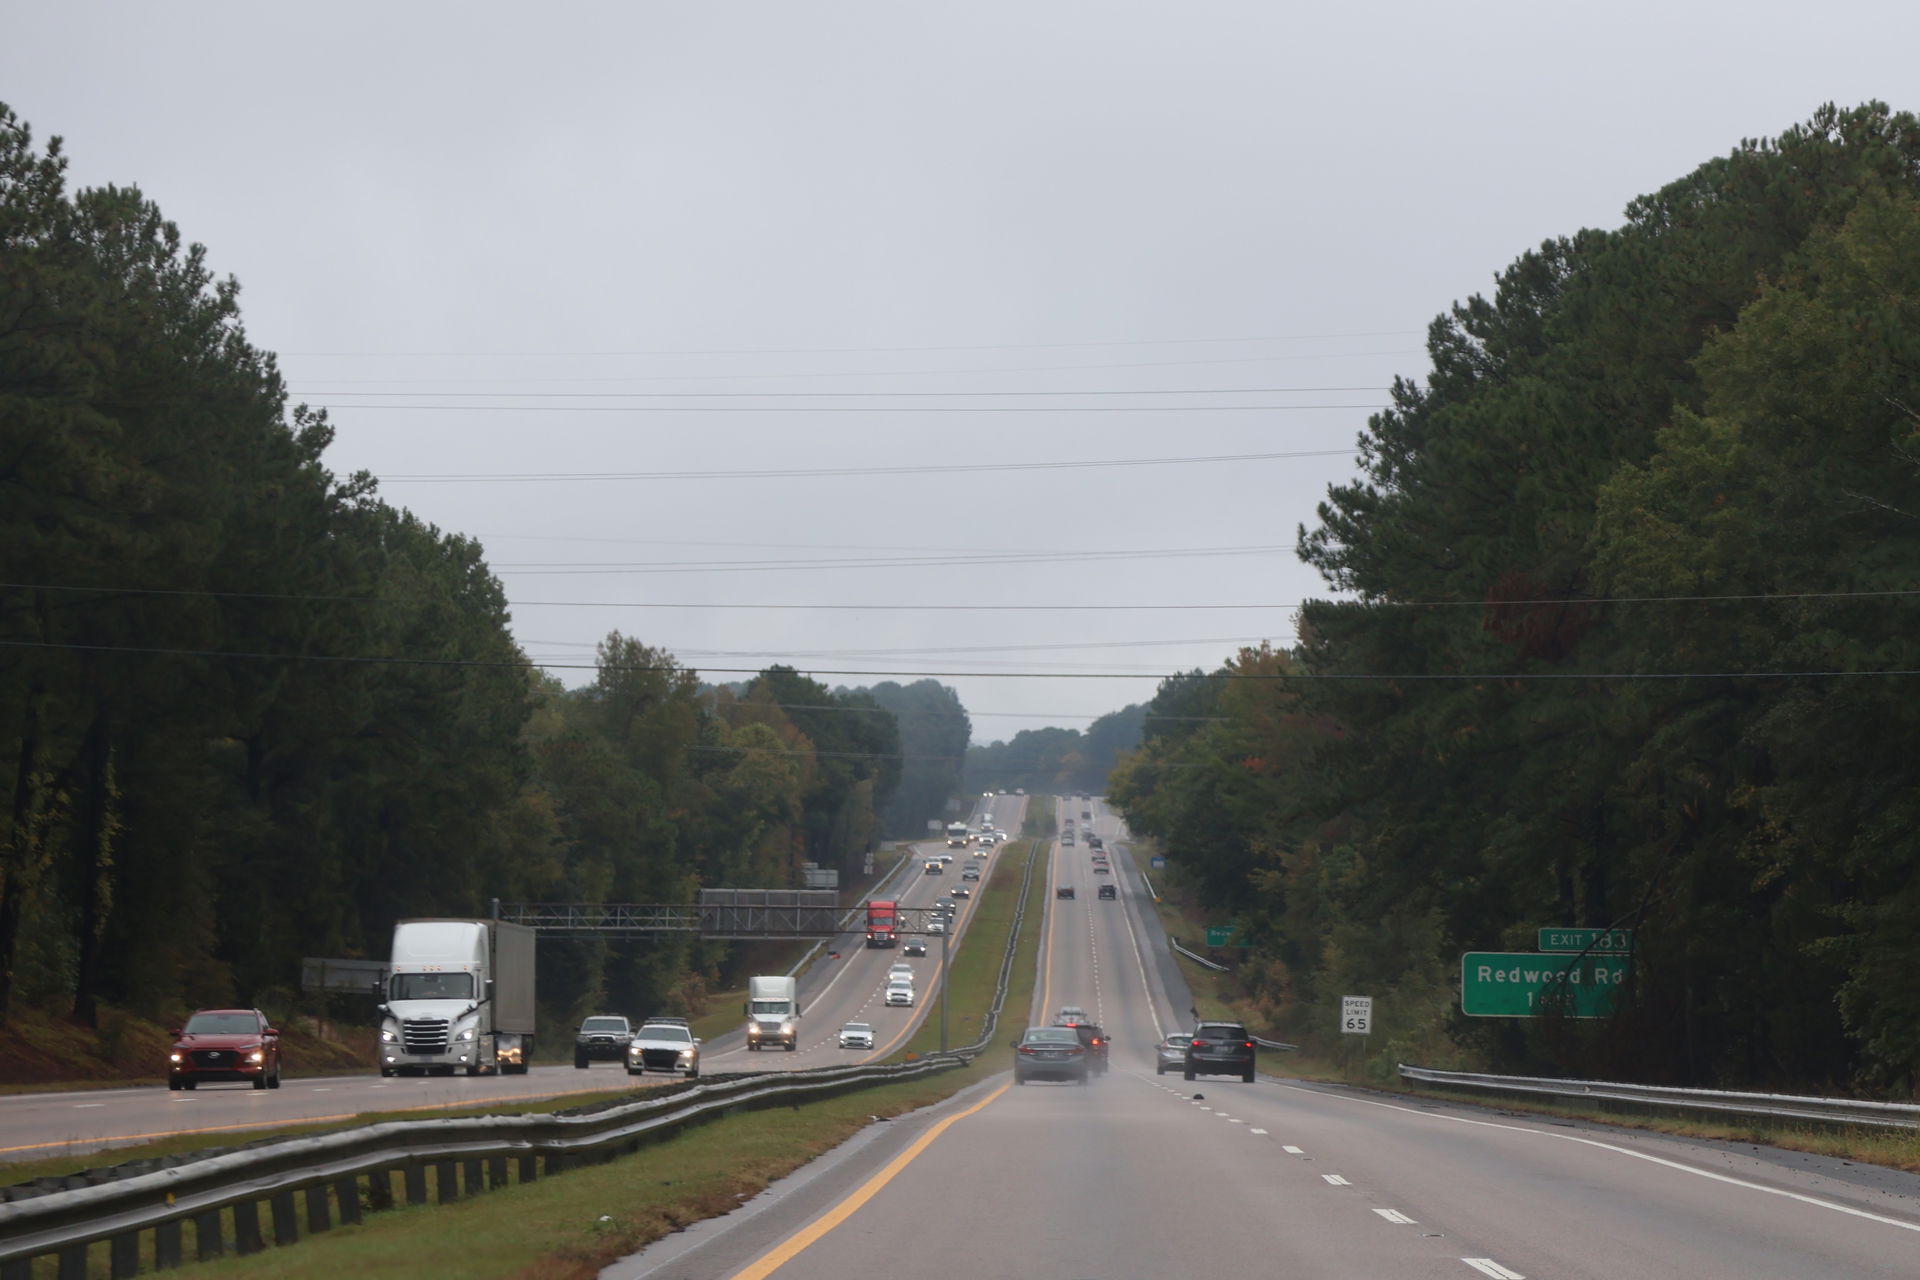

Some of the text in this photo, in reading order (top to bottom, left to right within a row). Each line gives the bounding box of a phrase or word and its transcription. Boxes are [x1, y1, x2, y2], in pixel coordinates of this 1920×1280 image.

[1550, 932, 1627, 949] EXIT 183
[1477, 965, 1624, 985] Redwood Rd
[1344, 1000, 1370, 1008] SPEED
[1526, 991, 1533, 1007] 1
[1346, 1018, 1366, 1030] 65
